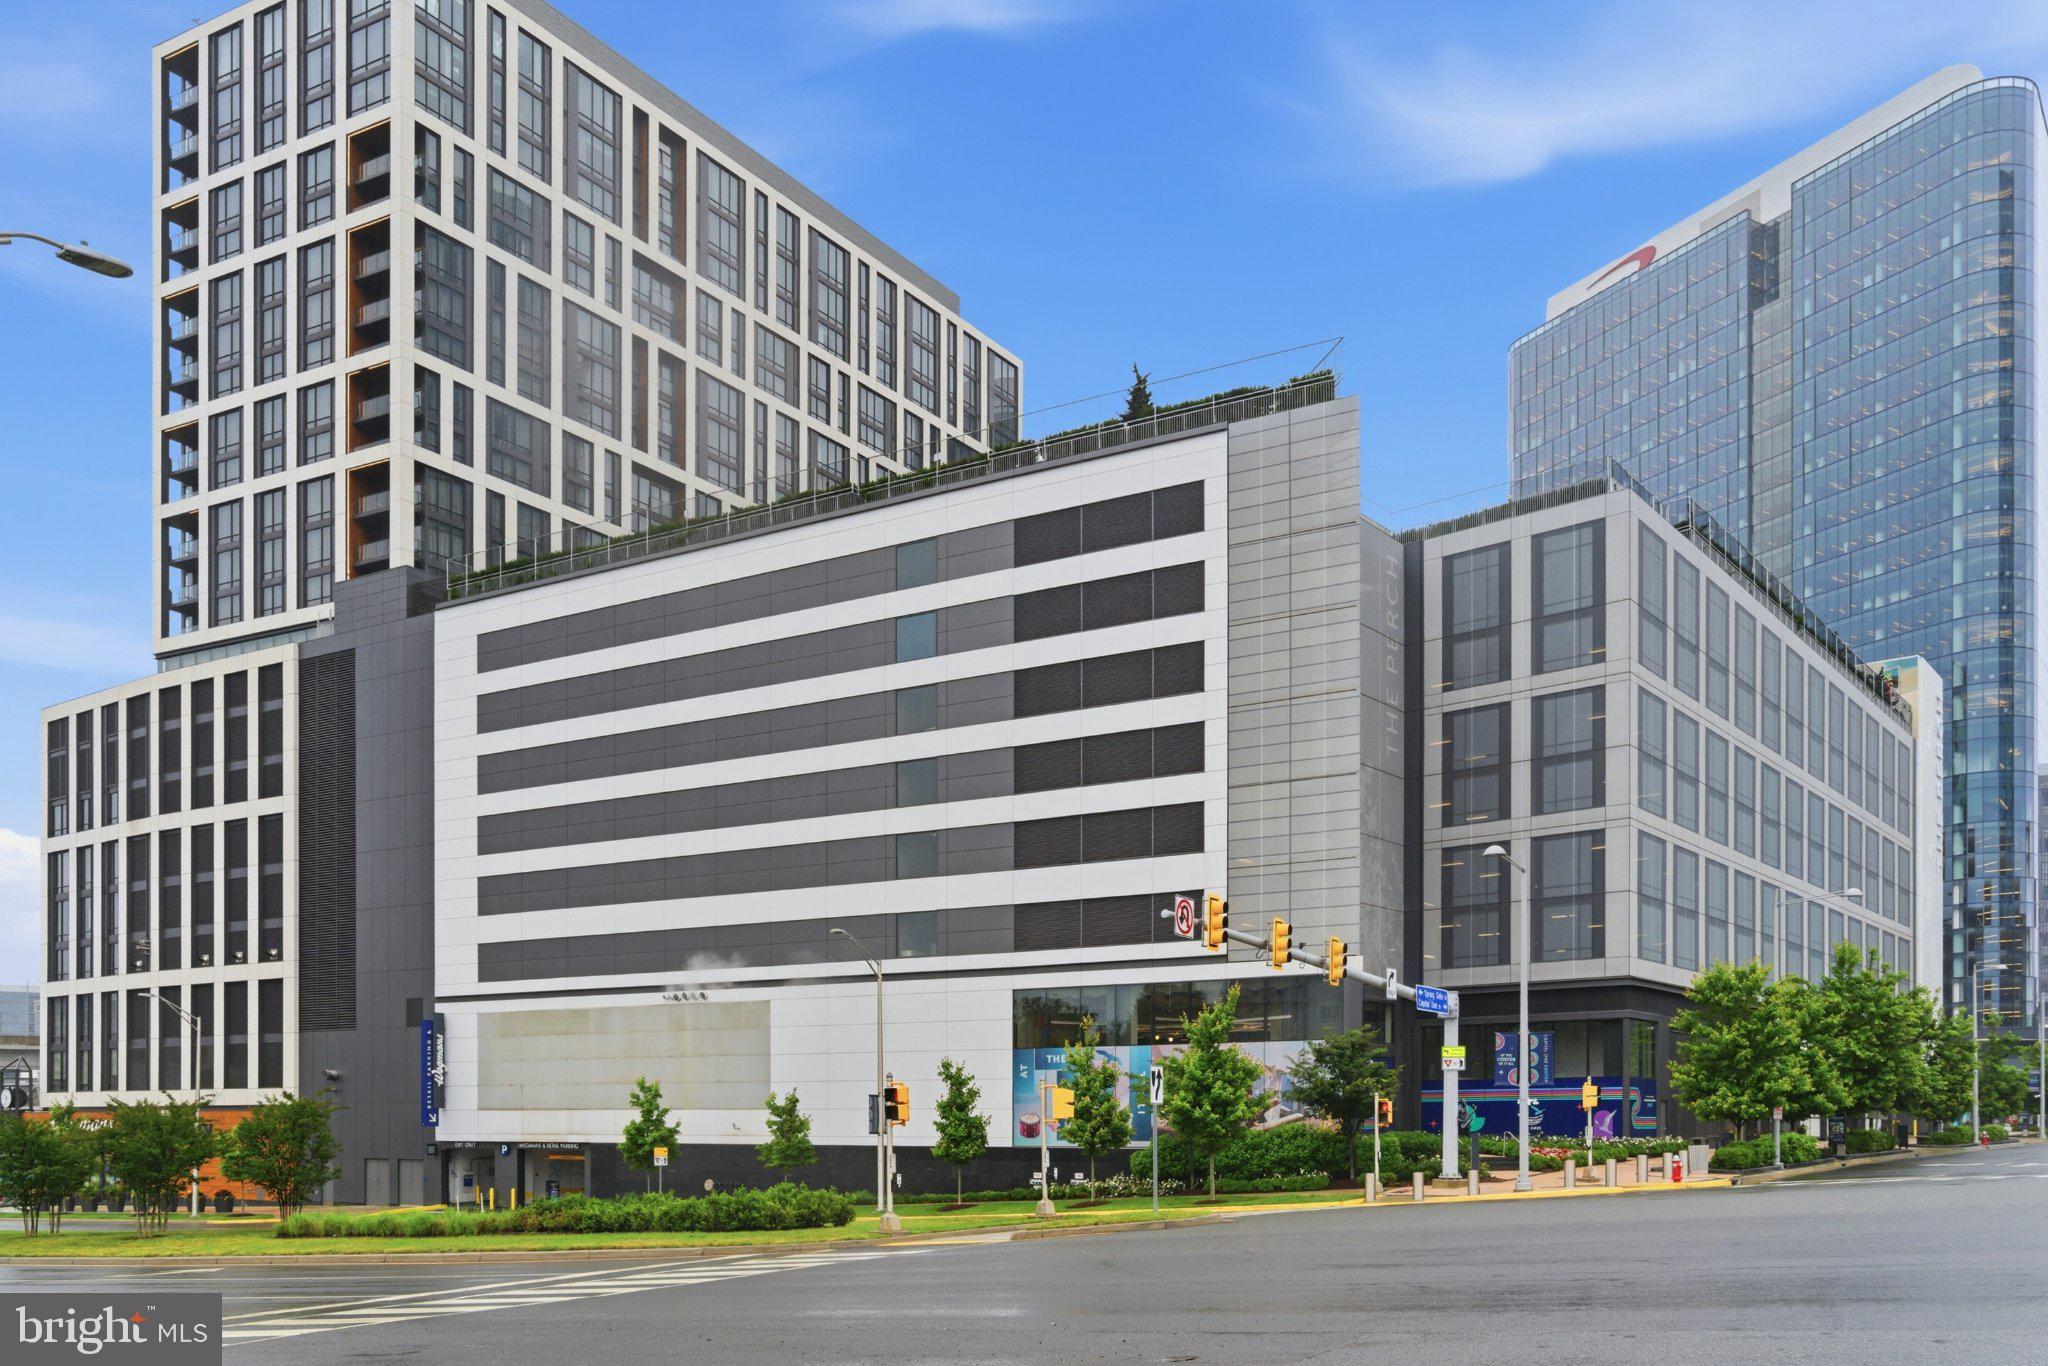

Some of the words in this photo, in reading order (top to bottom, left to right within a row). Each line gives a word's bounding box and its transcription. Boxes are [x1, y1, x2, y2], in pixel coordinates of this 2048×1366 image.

[1386, 555, 1399, 675] PERCH
[1386, 688, 1399, 758] THE
[431, 1034, 448, 1087] Wegmans
[1020, 1064, 1028, 1079] AT
